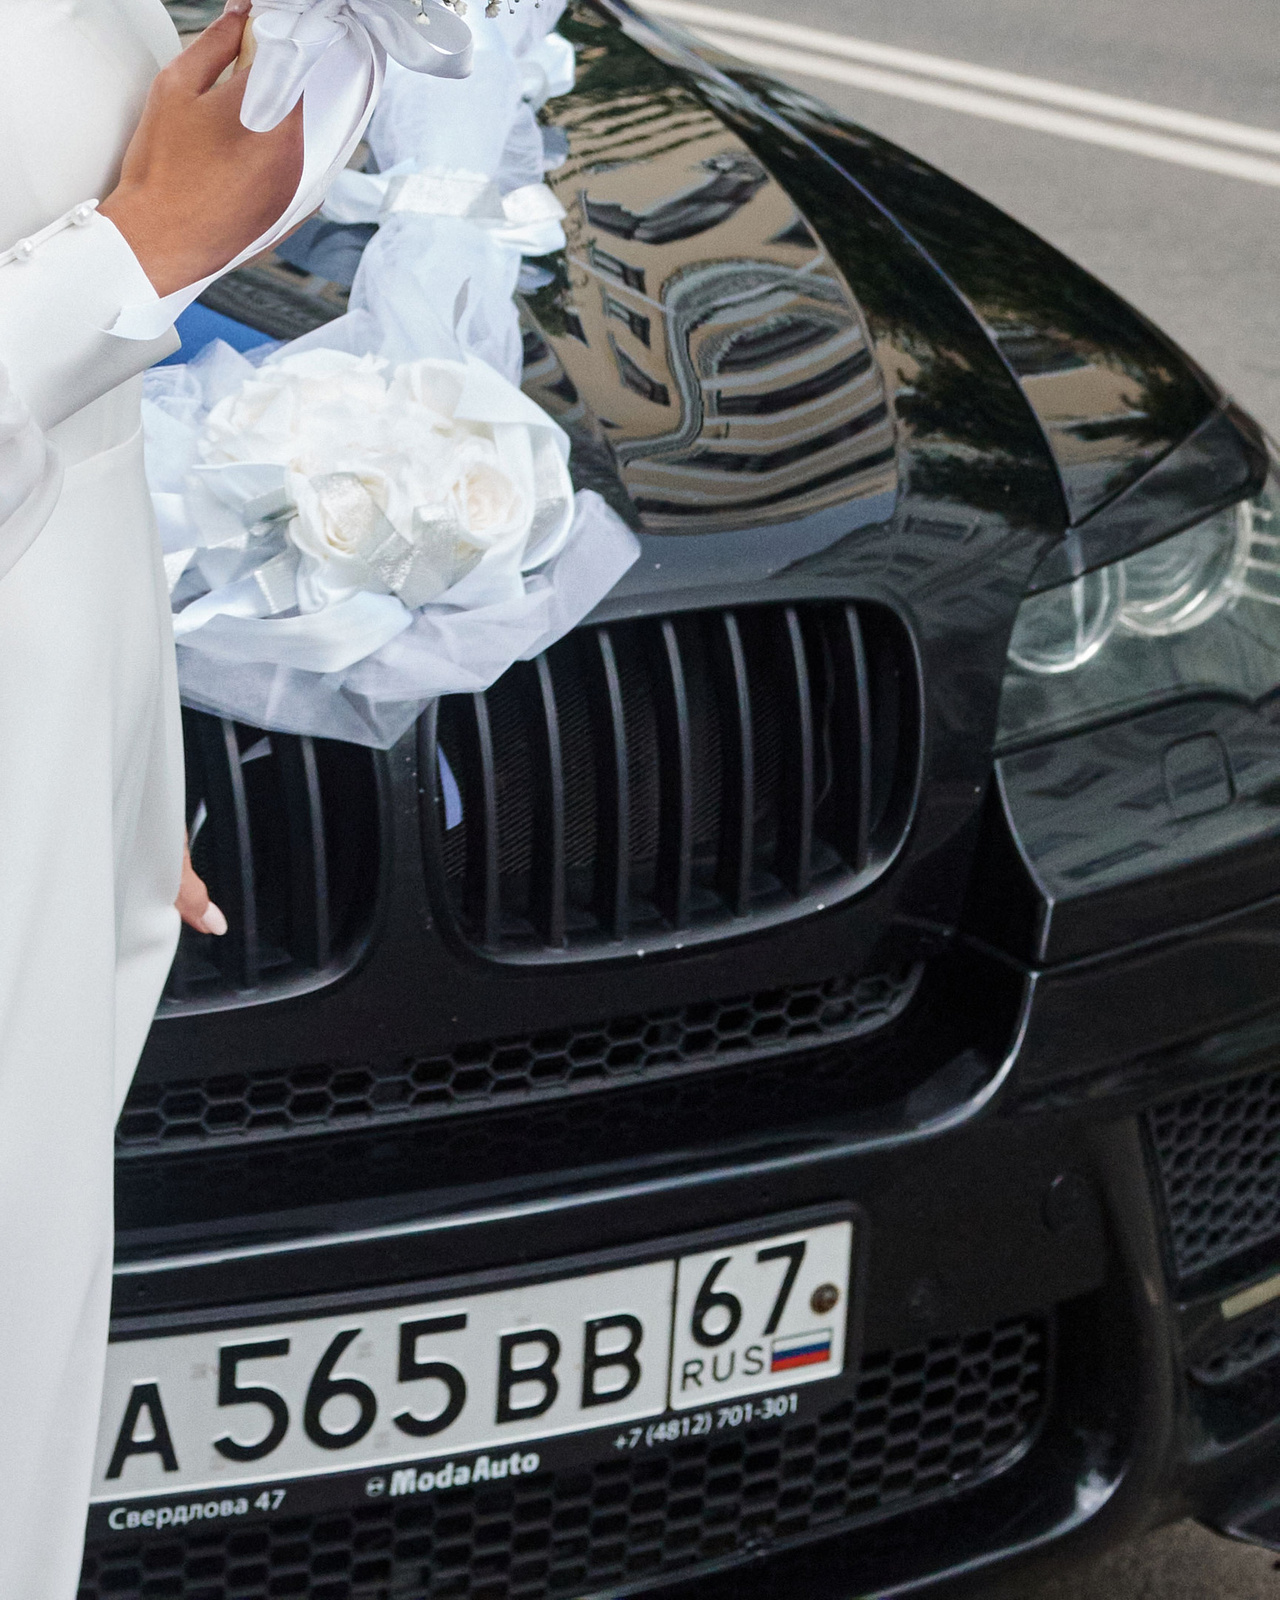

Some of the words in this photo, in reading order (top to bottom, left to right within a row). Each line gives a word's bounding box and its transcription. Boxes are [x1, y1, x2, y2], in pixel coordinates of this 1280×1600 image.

[692, 1240, 807, 1348] 67
[680, 1345, 764, 1392] RUS
[615, 1426, 641, 1450] +7
[645, 1414, 713, 1448] (4812)
[717, 1392, 799, 1430] 701-301
[388, 1452, 540, 1497] ModaAuto
[108, 1494, 250, 1531] Свердлова
[253, 1489, 288, 1513] 47
